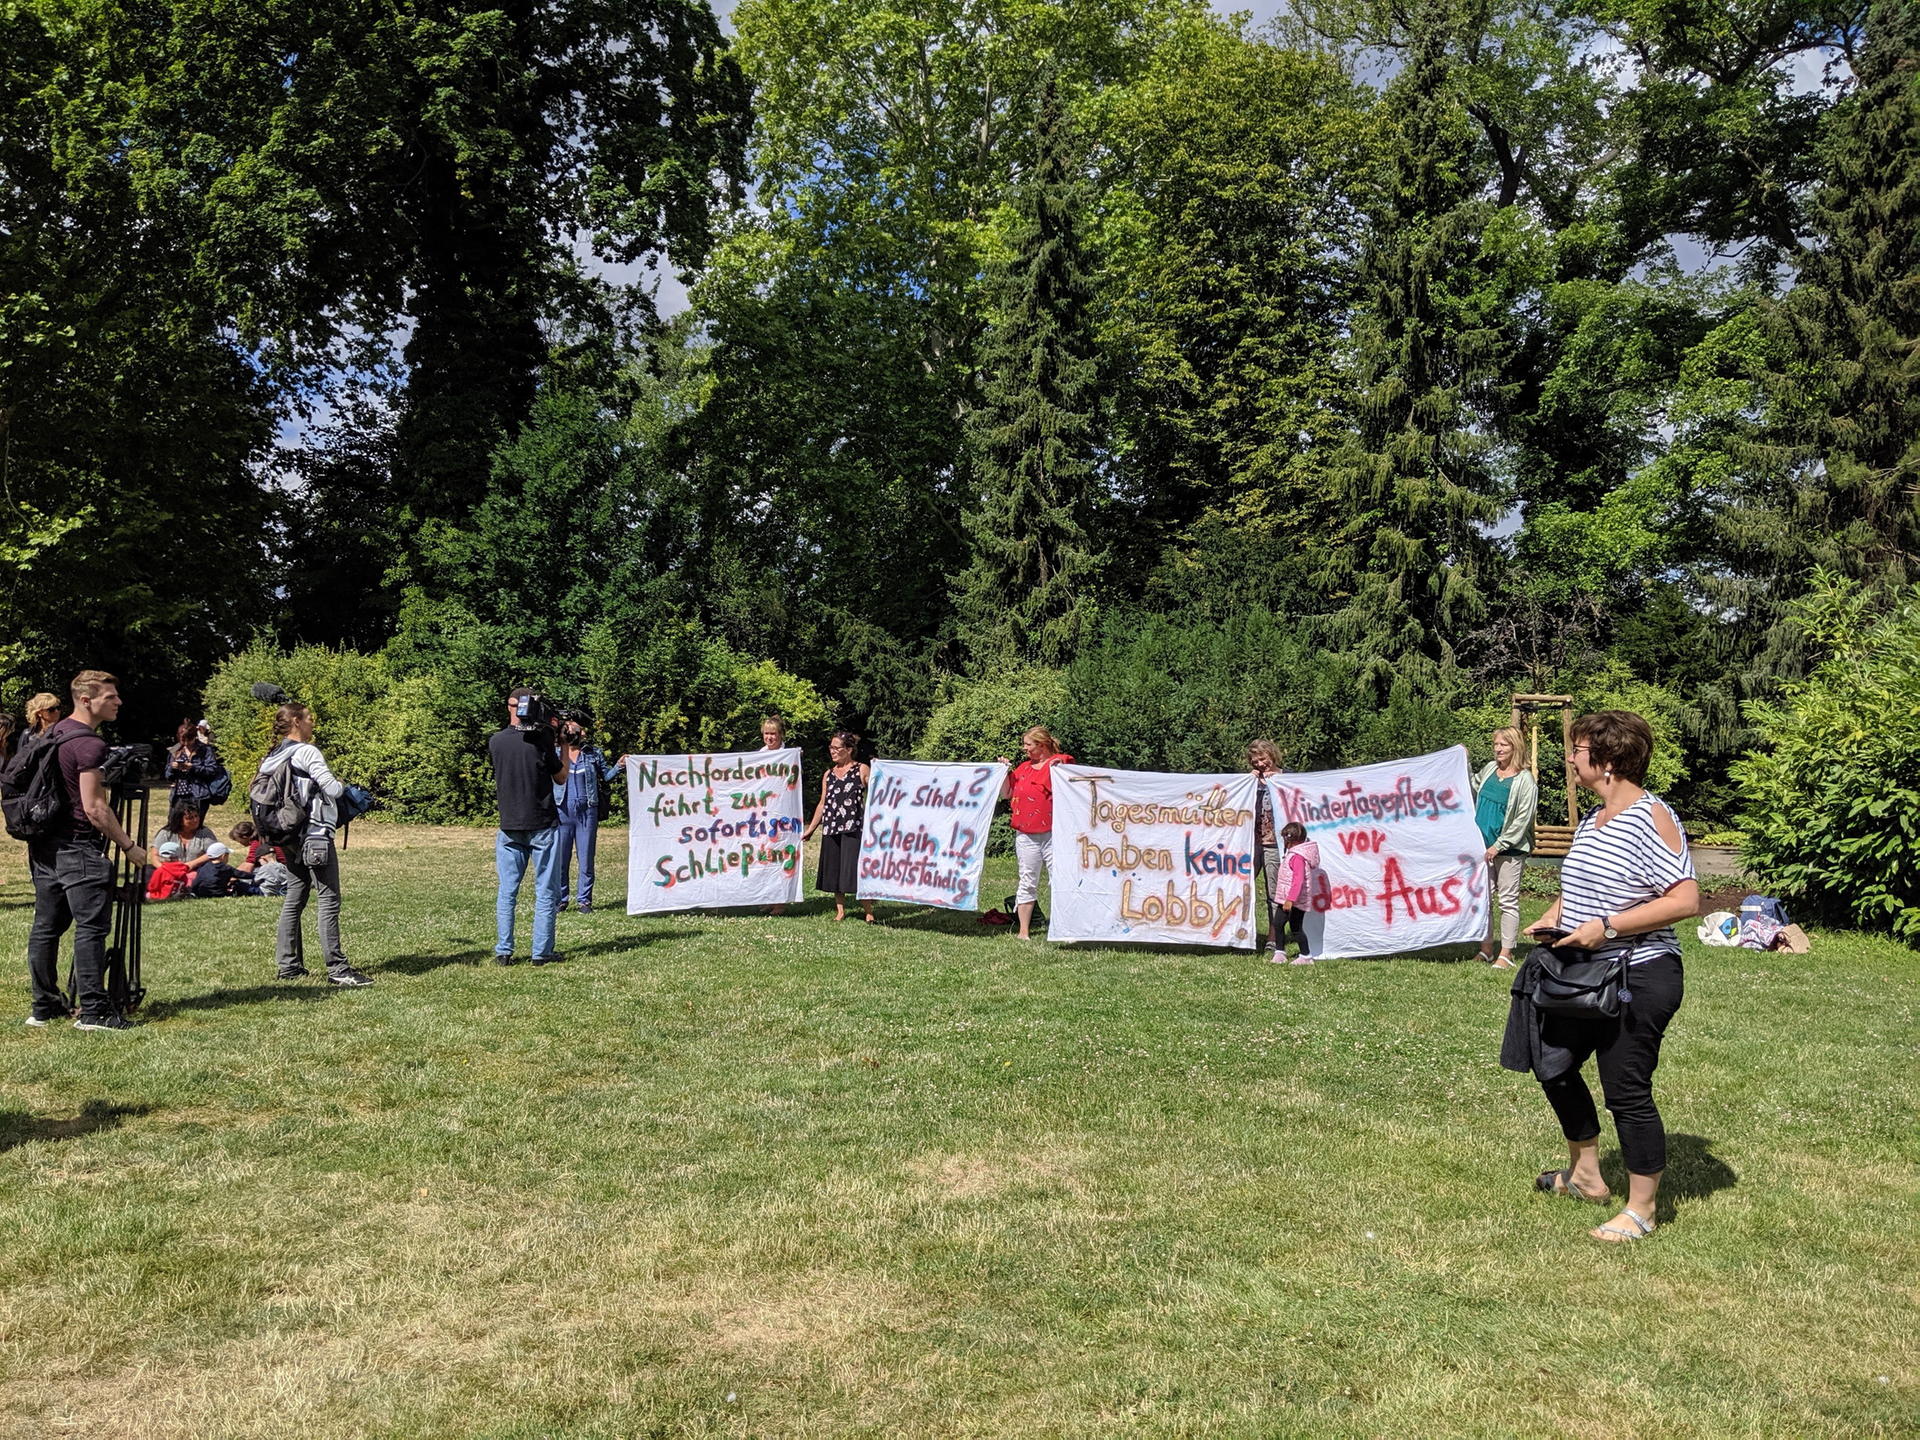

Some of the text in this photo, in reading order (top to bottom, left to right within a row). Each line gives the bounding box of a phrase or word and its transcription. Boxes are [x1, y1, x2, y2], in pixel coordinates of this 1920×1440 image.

[638, 755, 800, 791] Nachforderung
[869, 771, 908, 809] Wir
[647, 789, 780, 827] führt zur
[1068, 775, 1253, 833] Tagesmütter
[678, 811, 803, 844] sofortigen
[1338, 829, 1386, 855] vor
[1077, 831, 1251, 877] haben keine
[1121, 879, 1251, 941] Lobby!
[1311, 856, 1485, 926] dem Aus?
